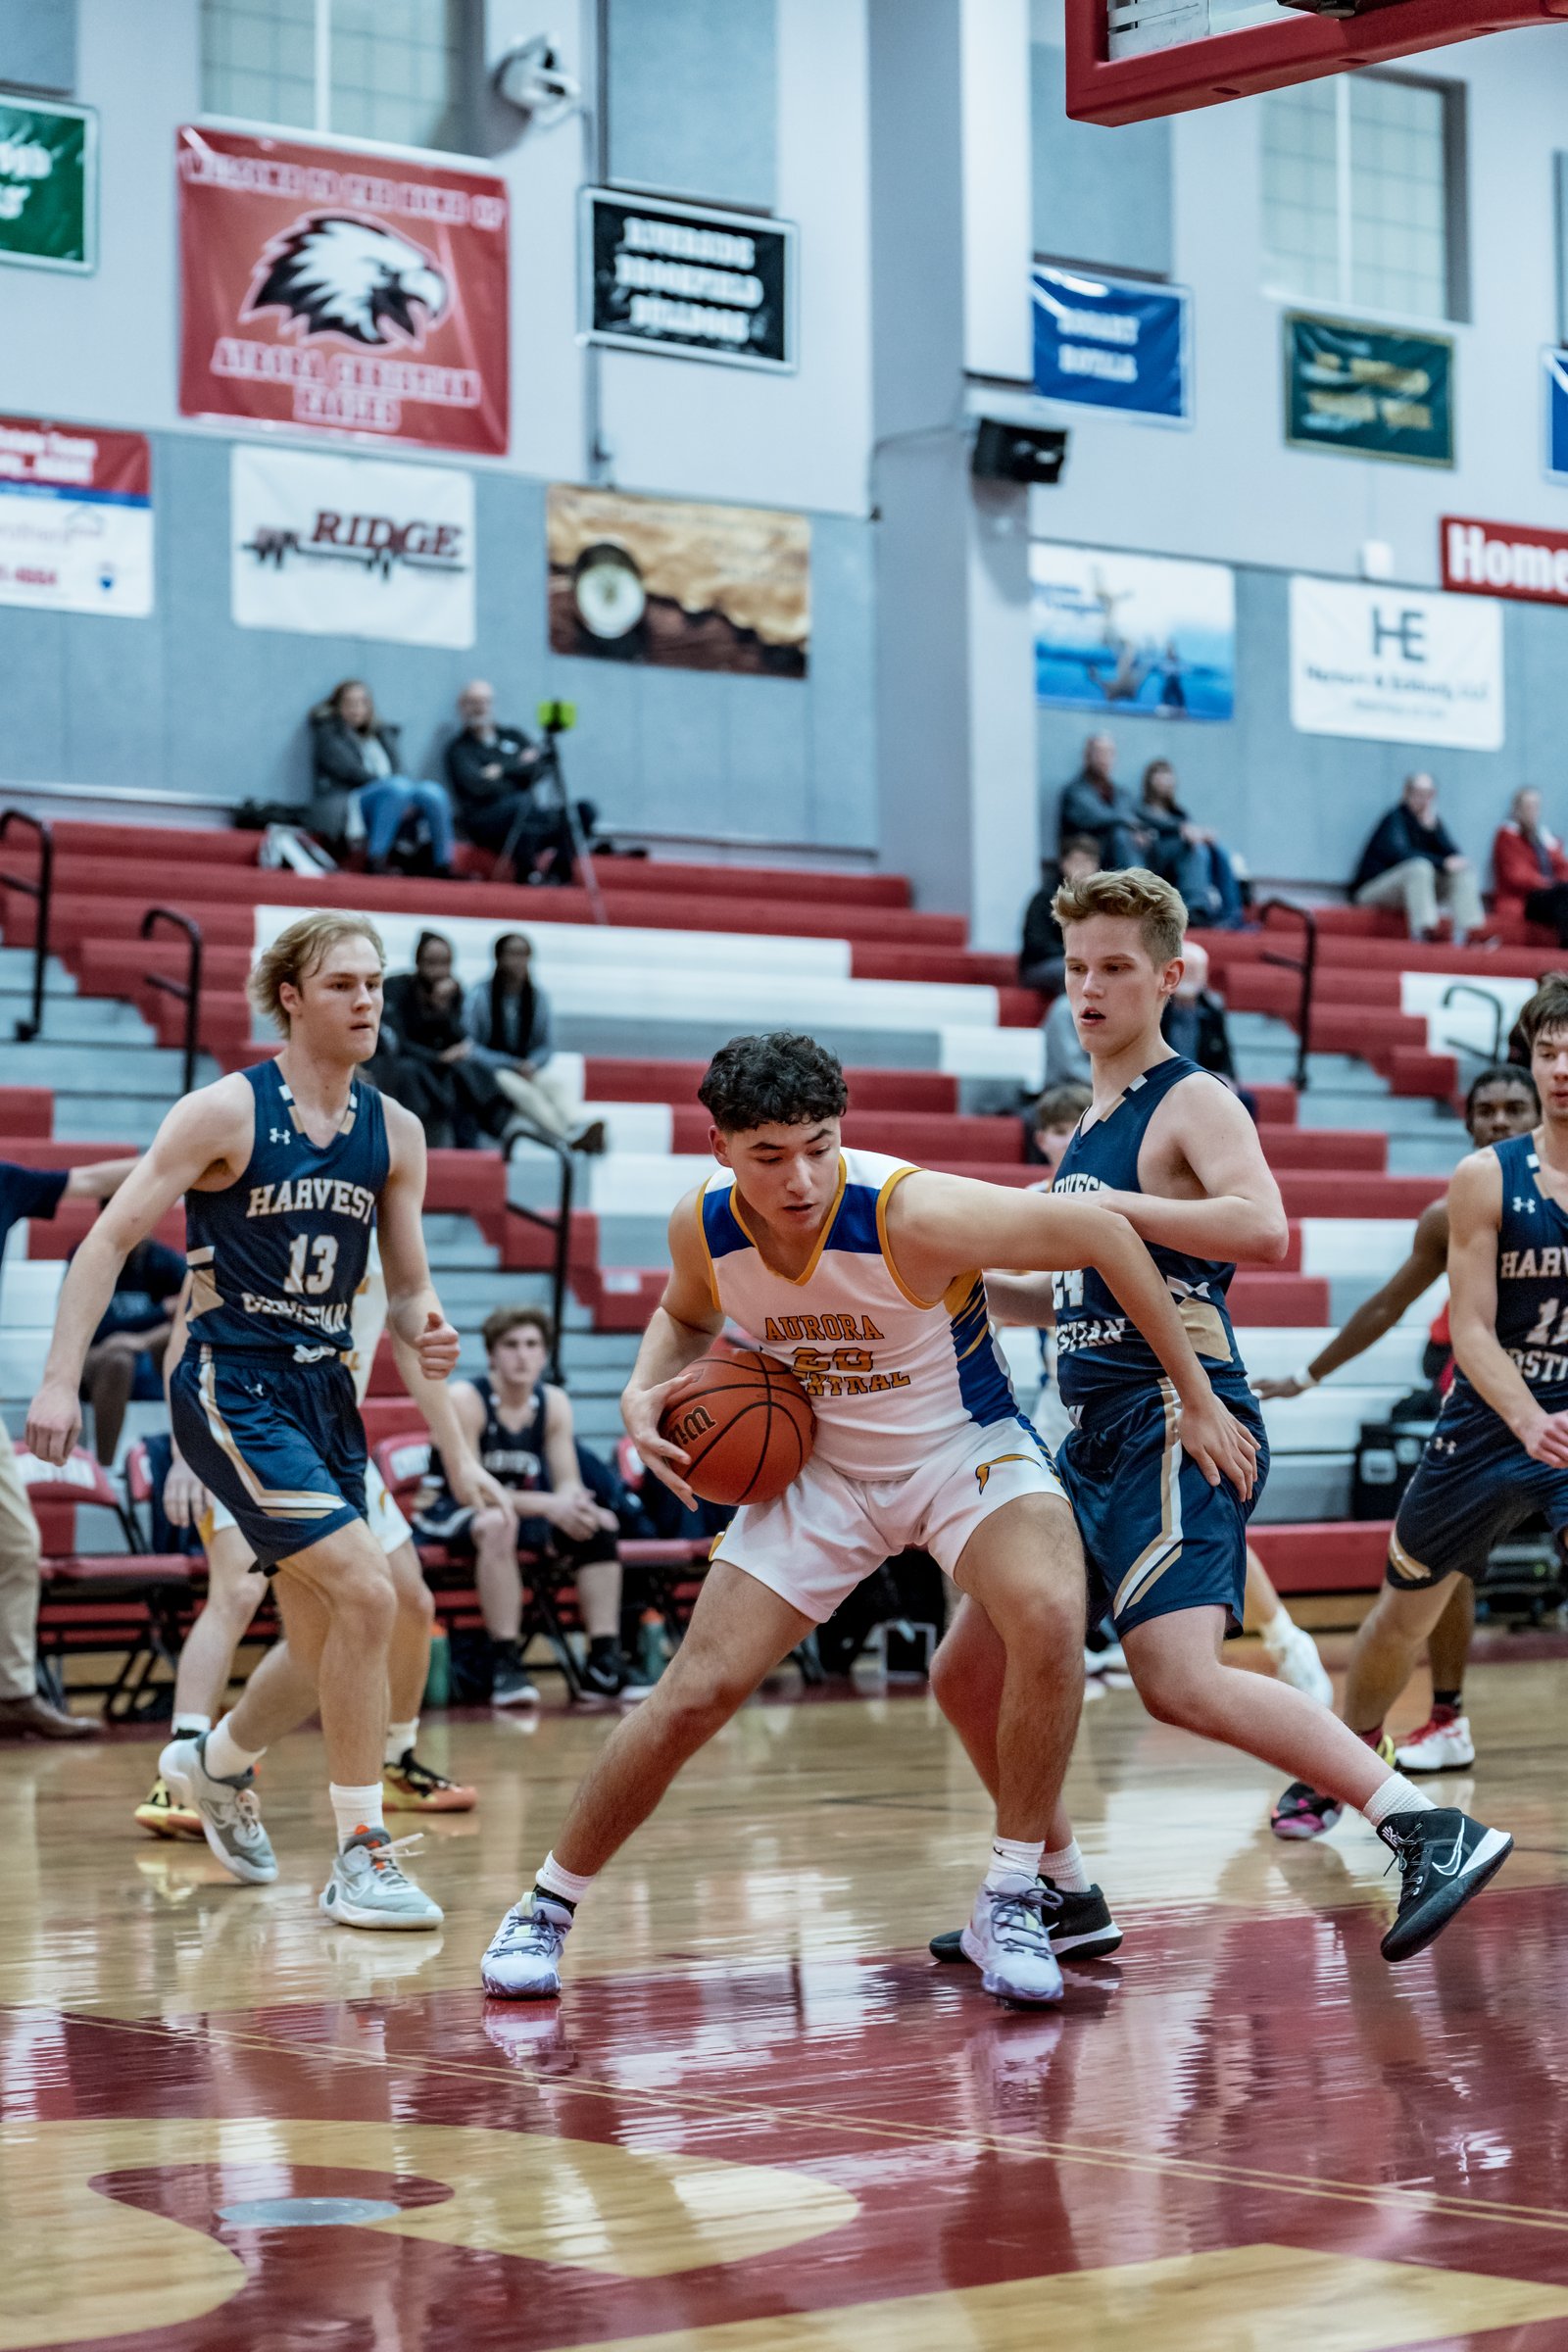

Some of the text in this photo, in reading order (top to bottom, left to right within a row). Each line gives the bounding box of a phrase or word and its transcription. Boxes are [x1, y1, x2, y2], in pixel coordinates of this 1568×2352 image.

[313, 512, 462, 557] RIDGE
[246, 1178, 375, 1224] HARVEST
[284, 1234, 339, 1295] 13
[1500, 1247, 1568, 1278] HAR
[765, 1314, 885, 1341] AURORA
[1056, 1318, 1125, 1356] STIAN
[793, 1371, 910, 1396] NTRAL
